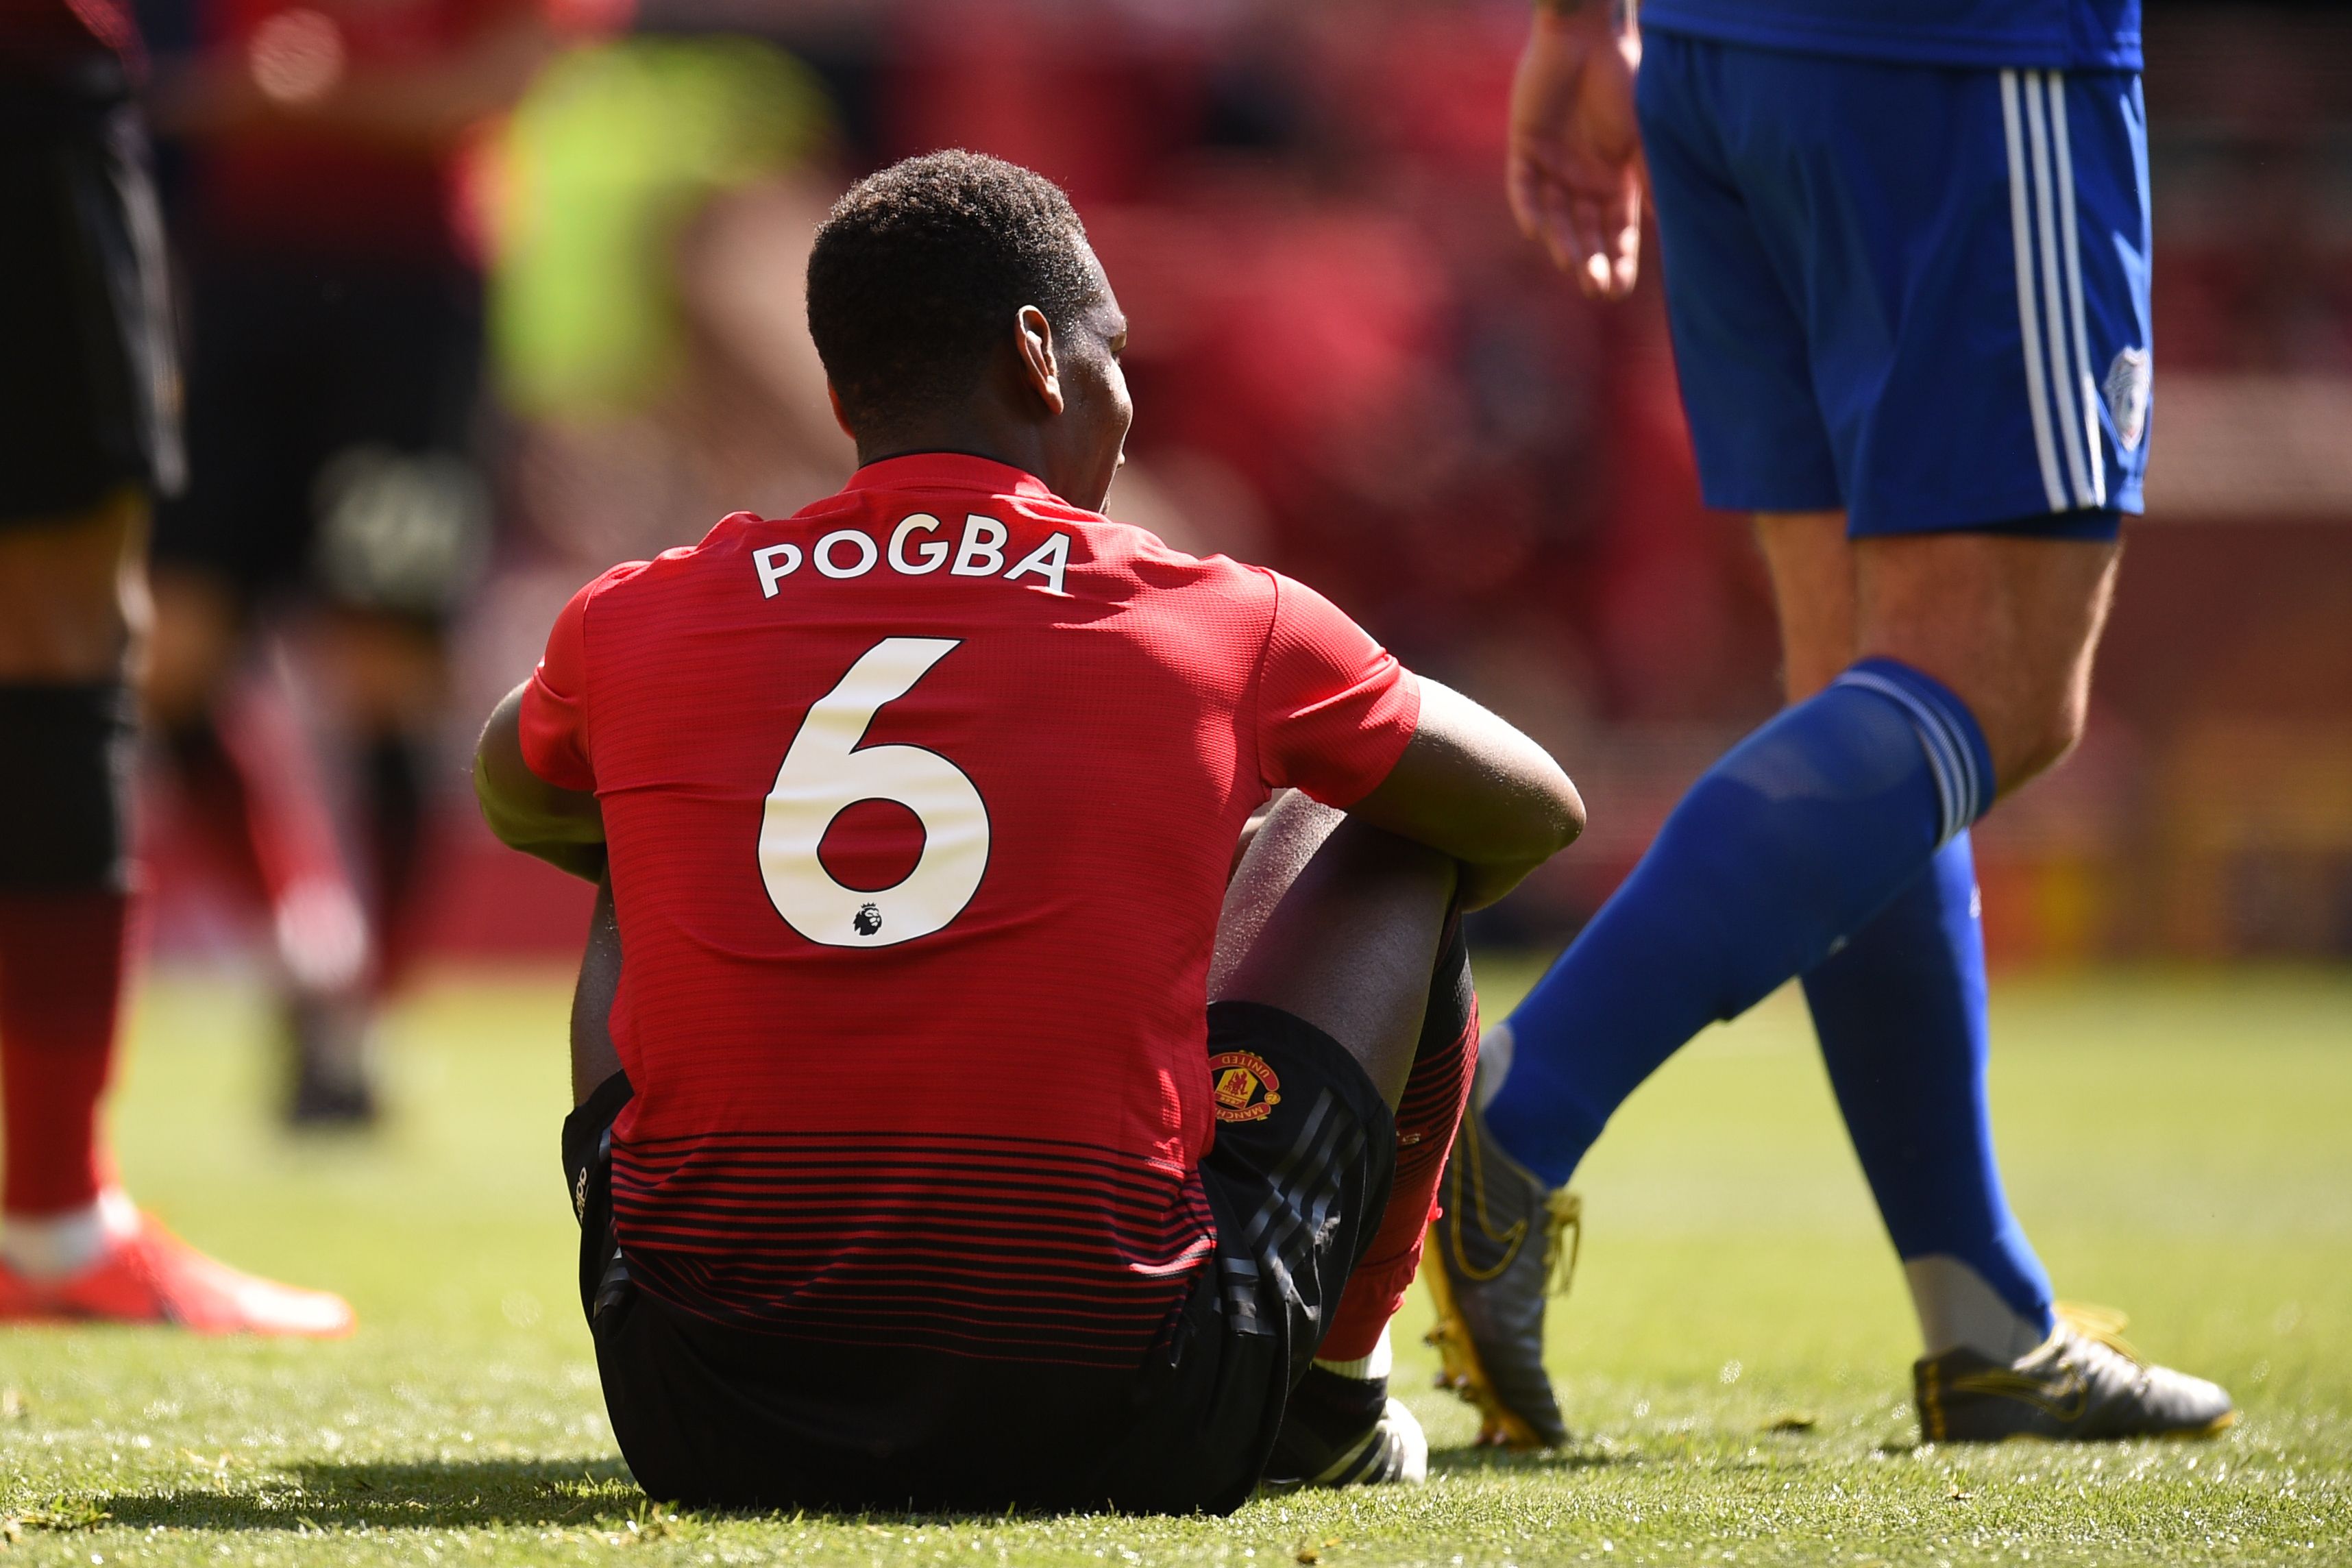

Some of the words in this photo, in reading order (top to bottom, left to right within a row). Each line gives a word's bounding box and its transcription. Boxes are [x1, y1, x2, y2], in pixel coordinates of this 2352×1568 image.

[752, 513, 1070, 599] POGBA
[757, 636, 991, 948] 6
[1221, 1055, 1270, 1078] UNITED
[1215, 1106, 1264, 1119] MANCH
